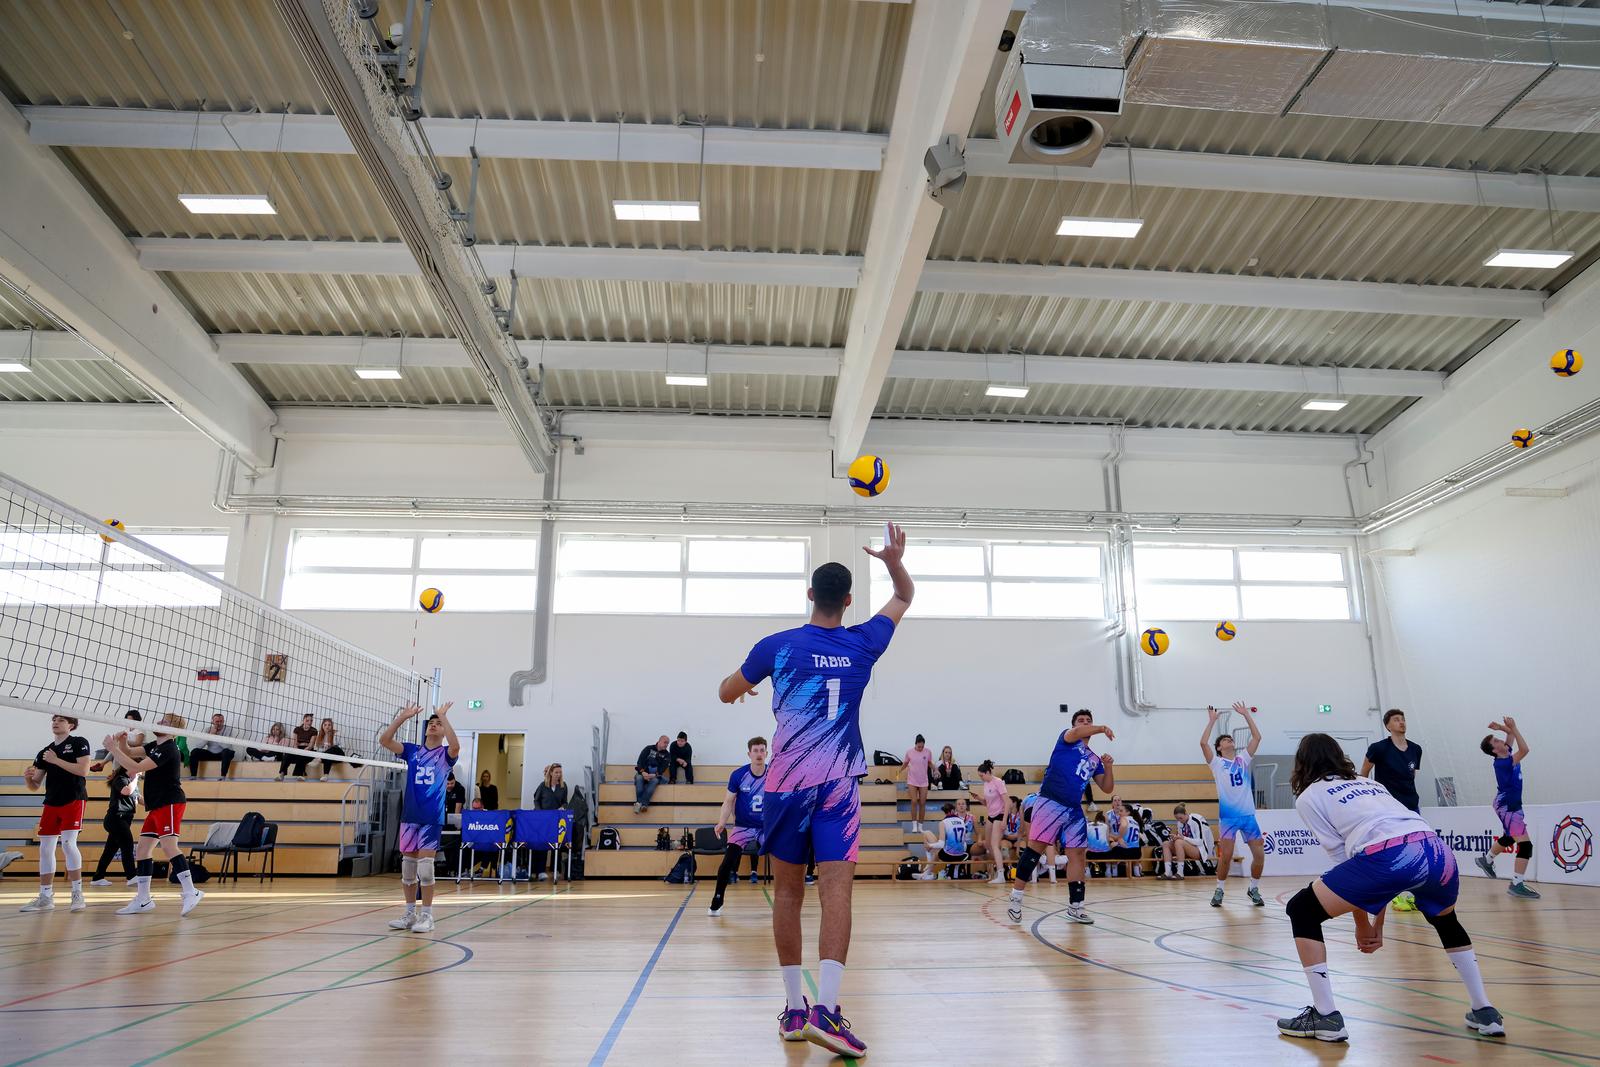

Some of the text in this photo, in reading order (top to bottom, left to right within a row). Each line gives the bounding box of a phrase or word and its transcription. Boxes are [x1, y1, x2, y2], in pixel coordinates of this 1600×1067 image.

[826, 678, 841, 720] 1
[415, 765, 435, 785] 25
[1230, 772, 1243, 787] 19
[752, 795, 763, 812] 2
[953, 827, 965, 843] 17
[1095, 828, 1100, 840] 1
[1127, 826, 1139, 843] 16
[1274, 830, 1314, 838] HRVATSKI
[1278, 847, 1304, 855] SAVEZ
